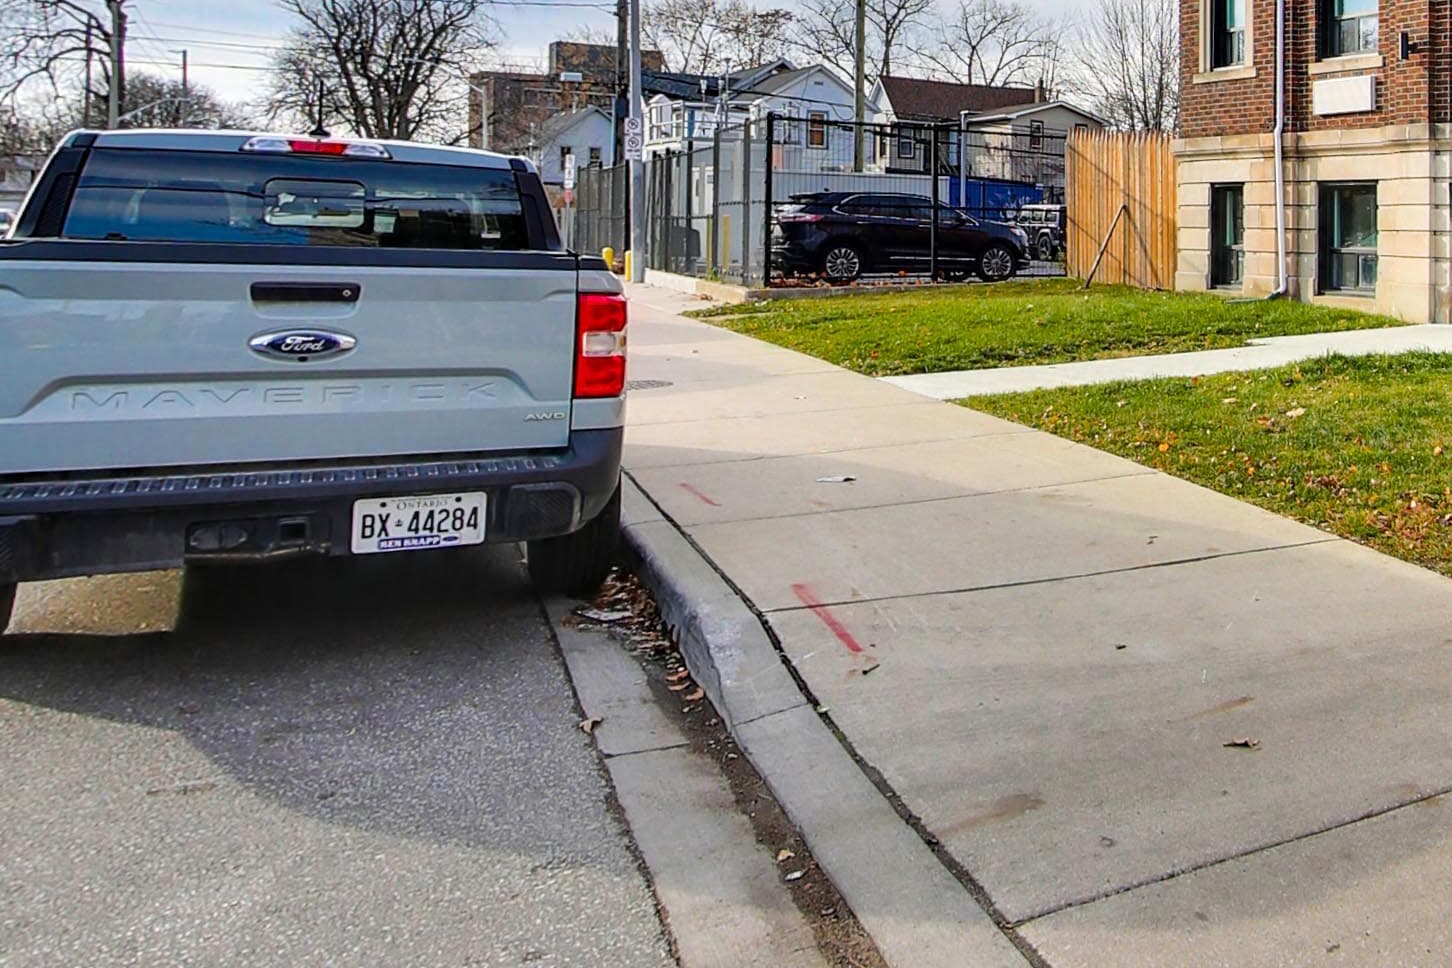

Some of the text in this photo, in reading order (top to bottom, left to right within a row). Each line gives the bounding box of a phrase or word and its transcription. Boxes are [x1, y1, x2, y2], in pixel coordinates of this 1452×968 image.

[281, 336, 326, 351] Ford
[71, 382, 497, 410] MAVERICK
[523, 412, 565, 421] AWD
[361, 506, 479, 539] BX 44284
